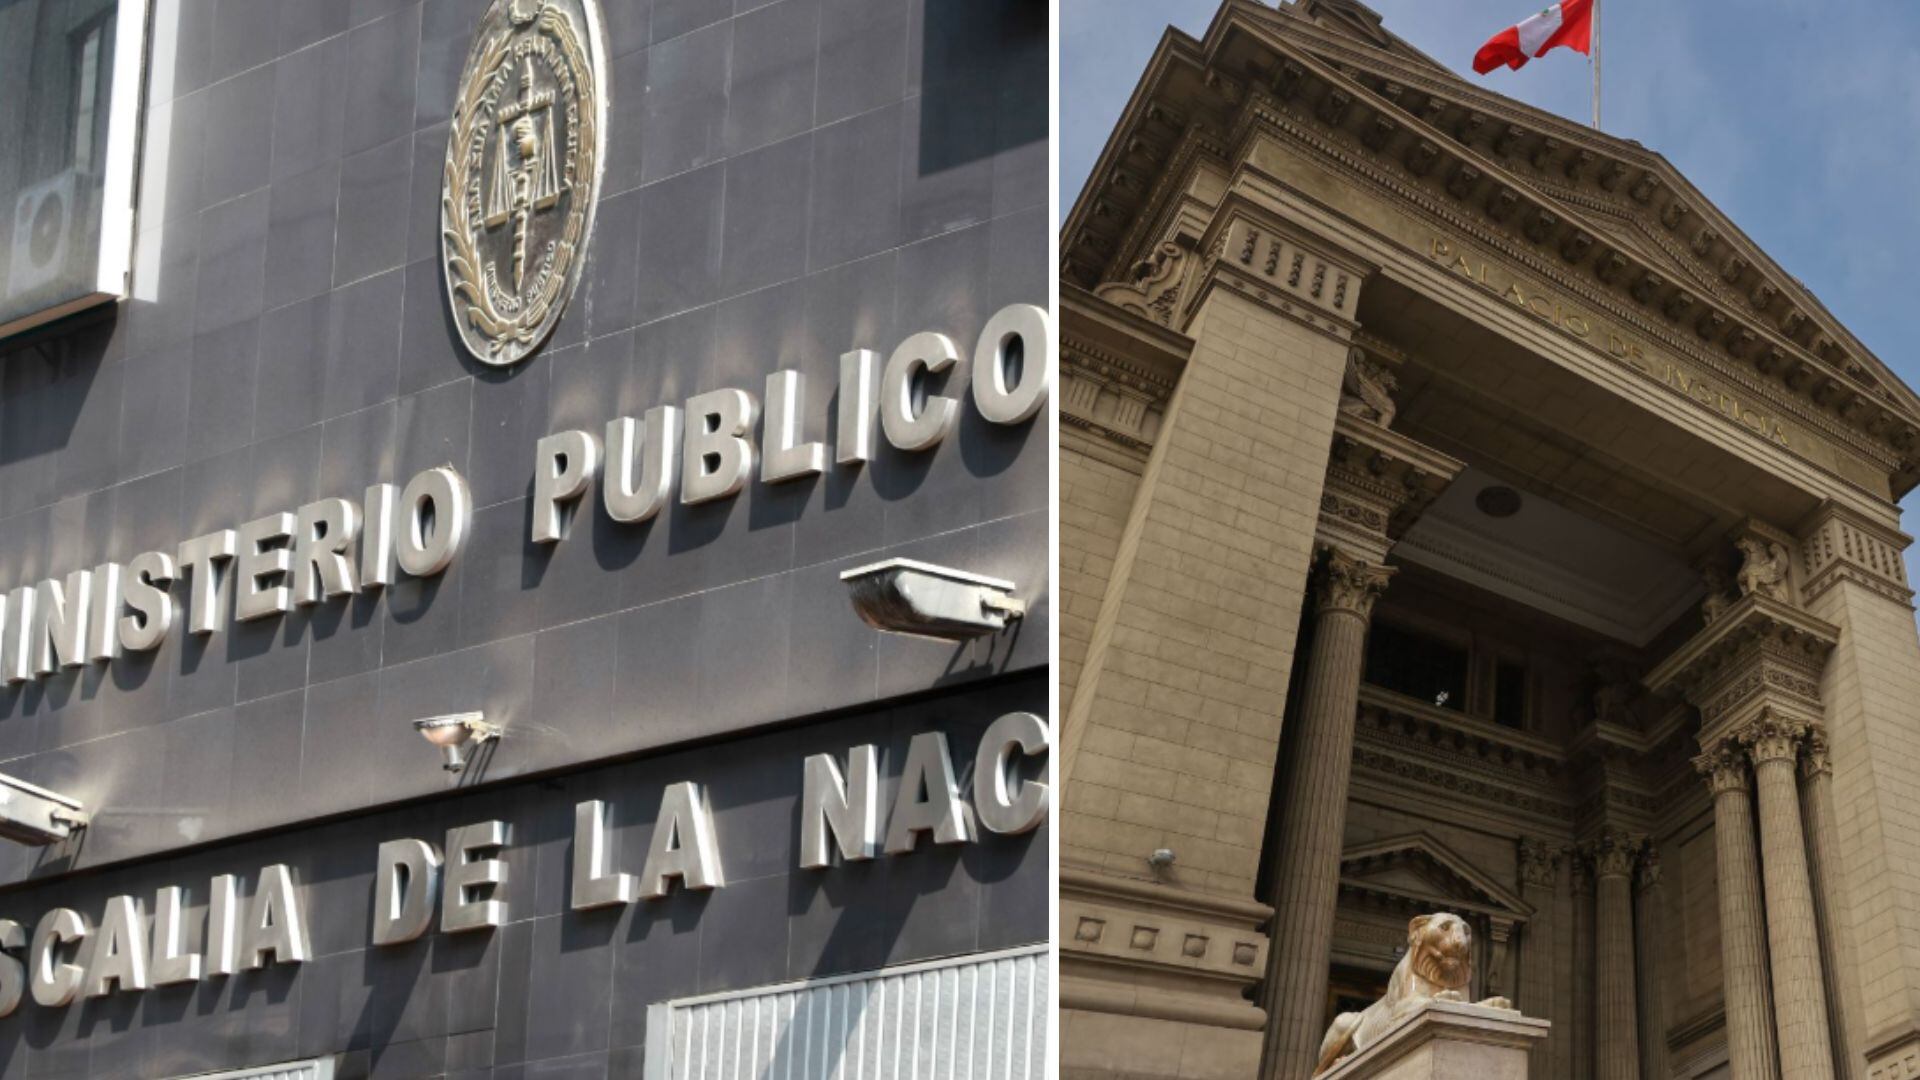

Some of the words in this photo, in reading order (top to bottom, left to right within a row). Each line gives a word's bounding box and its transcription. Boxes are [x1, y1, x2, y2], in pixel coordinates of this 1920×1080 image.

[1430, 237, 1590, 338] PALACIO
[1608, 333, 1648, 372] DE
[0, 466, 471, 687] INISTERIO
[531, 303, 1049, 543] PUBLICO
[373, 820, 511, 946] DE
[571, 781, 725, 910] LA
[799, 711, 1049, 868] NAC
